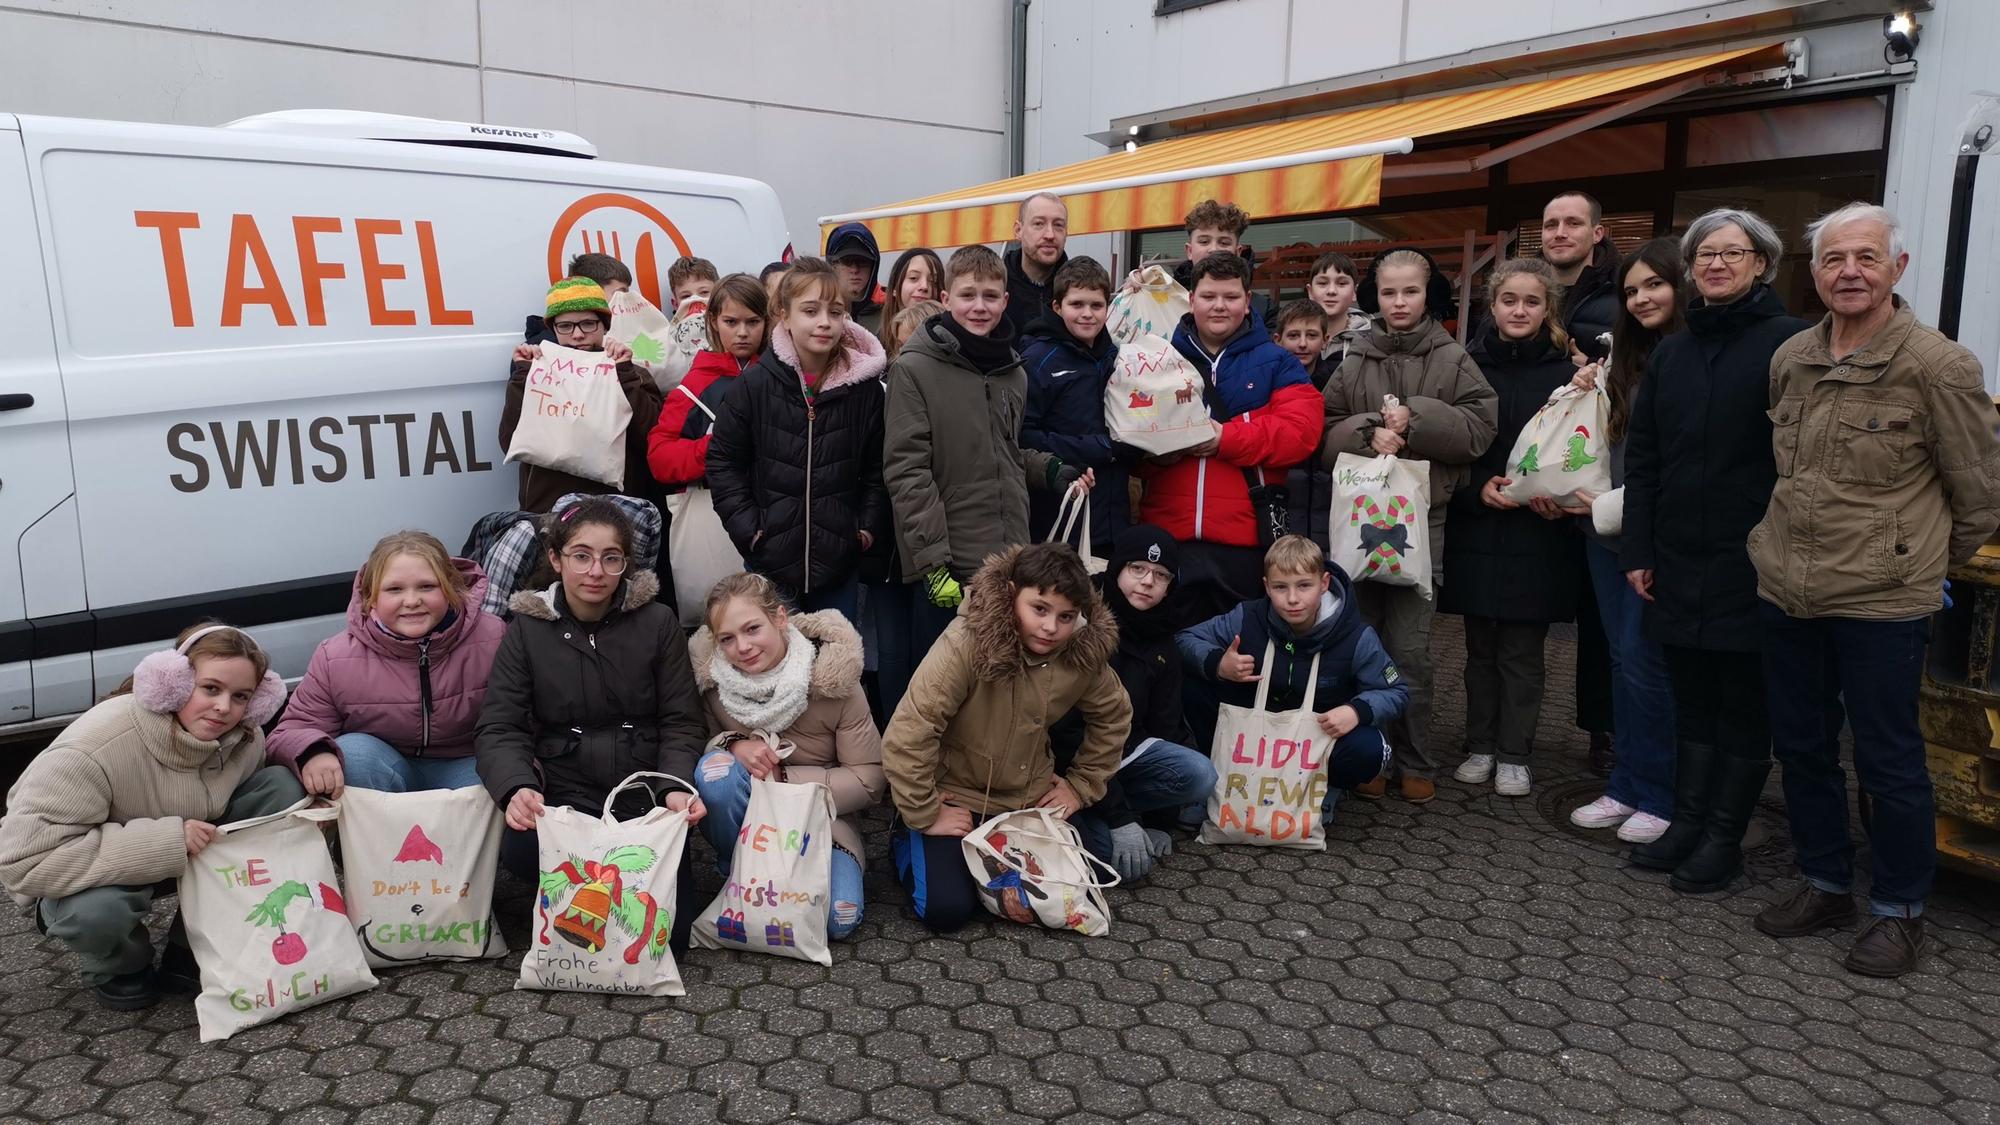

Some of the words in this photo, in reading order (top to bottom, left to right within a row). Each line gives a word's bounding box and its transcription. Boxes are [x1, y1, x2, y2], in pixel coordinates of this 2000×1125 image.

[470, 126, 539, 139] Kerstner
[134, 210, 474, 328] TAFEL
[530, 388, 585, 417] Tafel
[166, 410, 493, 493] SWISTTAL
[1231, 732, 1321, 770] LIDL
[1218, 802, 1313, 841] ALDI
[214, 858, 272, 889] THE
[431, 879, 453, 895] be
[459, 882, 470, 898] a
[537, 949, 599, 974] Frohe
[229, 971, 329, 1012] GRINCH
[534, 968, 646, 993] Weihnachten
